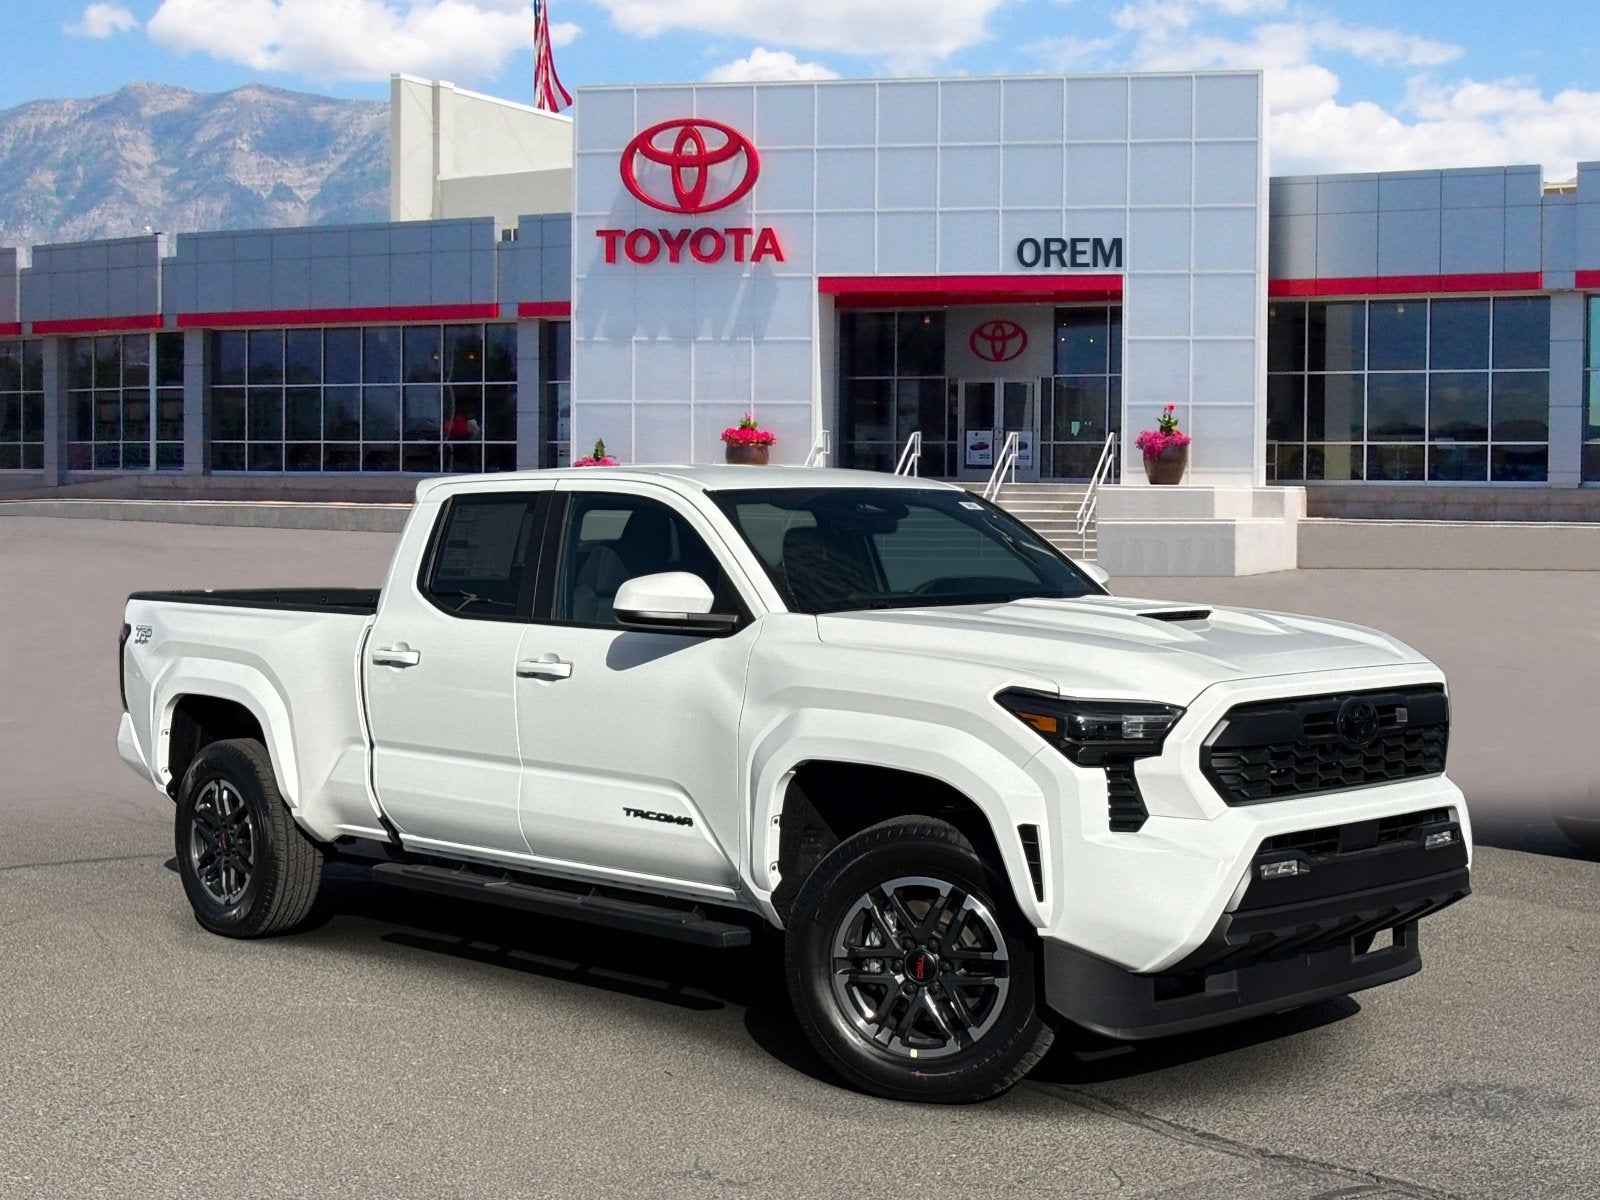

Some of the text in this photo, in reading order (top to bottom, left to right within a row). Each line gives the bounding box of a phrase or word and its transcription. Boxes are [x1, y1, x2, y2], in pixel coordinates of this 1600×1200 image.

[596, 227, 785, 264] TOYOTA
[1017, 237, 1123, 268] OREM
[622, 806, 694, 827] TACOMA
